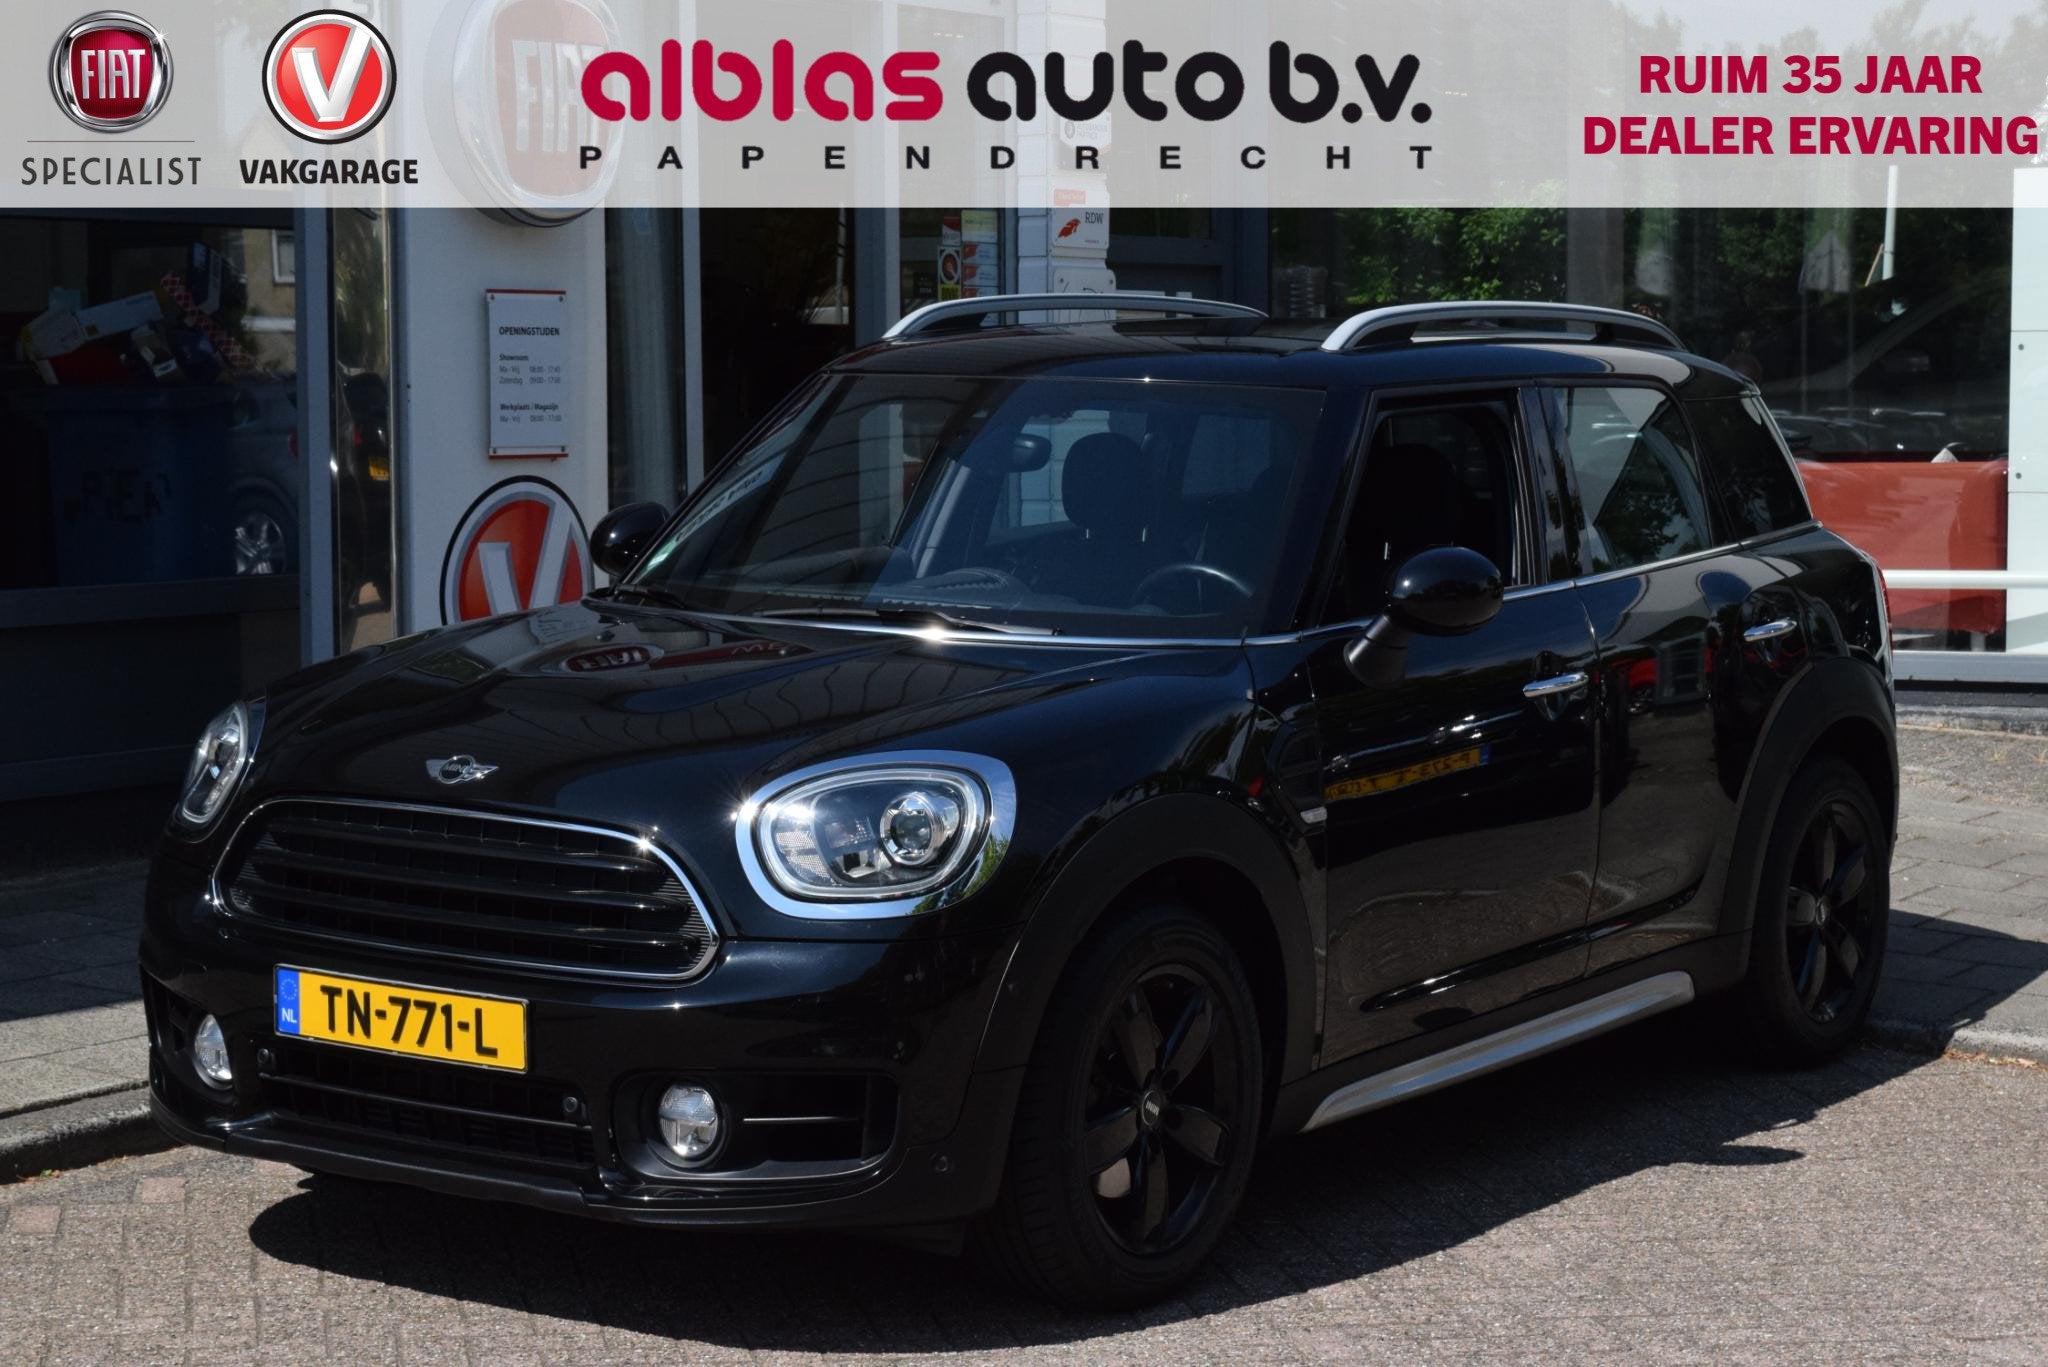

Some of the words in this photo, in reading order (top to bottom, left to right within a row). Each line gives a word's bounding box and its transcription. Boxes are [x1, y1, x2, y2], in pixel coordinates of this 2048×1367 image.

[1085, 212, 1104, 224] RDW
[282, 1008, 297, 1023] NL
[320, 984, 498, 1059] TN-771-L
